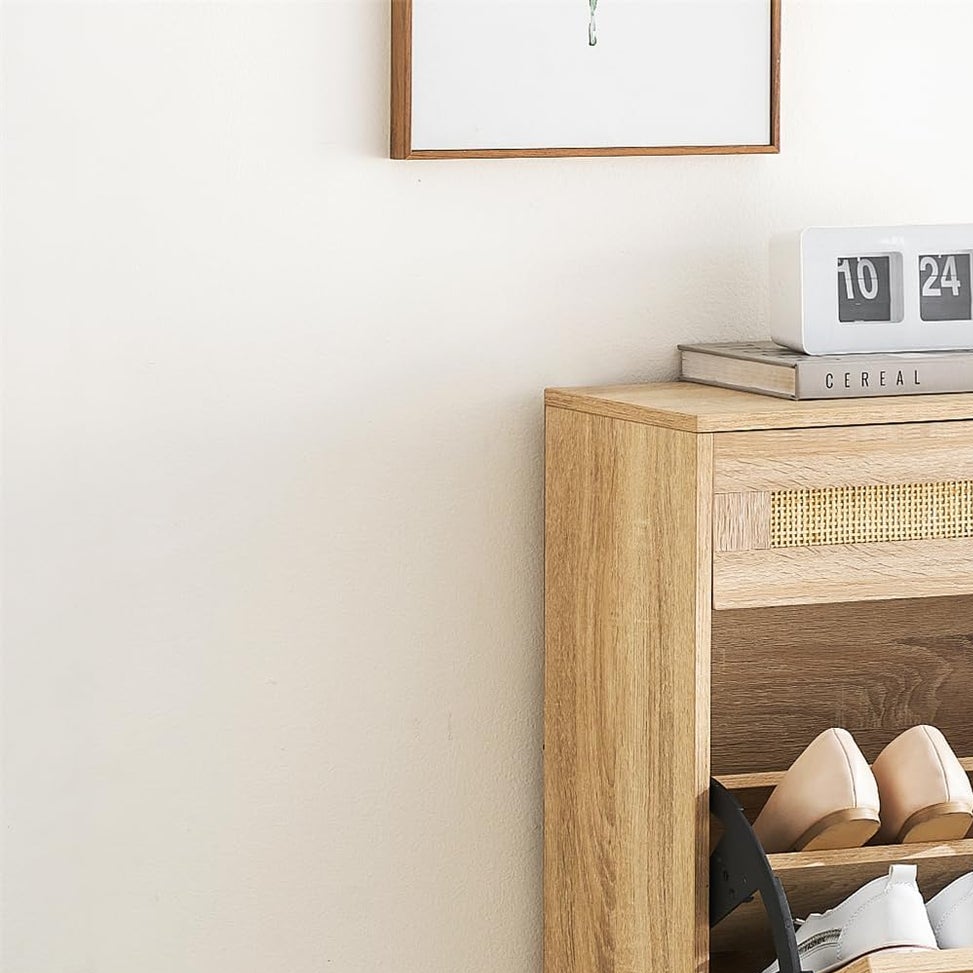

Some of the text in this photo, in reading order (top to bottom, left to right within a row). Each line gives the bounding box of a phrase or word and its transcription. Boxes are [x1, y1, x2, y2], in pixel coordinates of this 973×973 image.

[838, 256, 961, 300] 10 24
[825, 370, 921, 389] CEREAL
